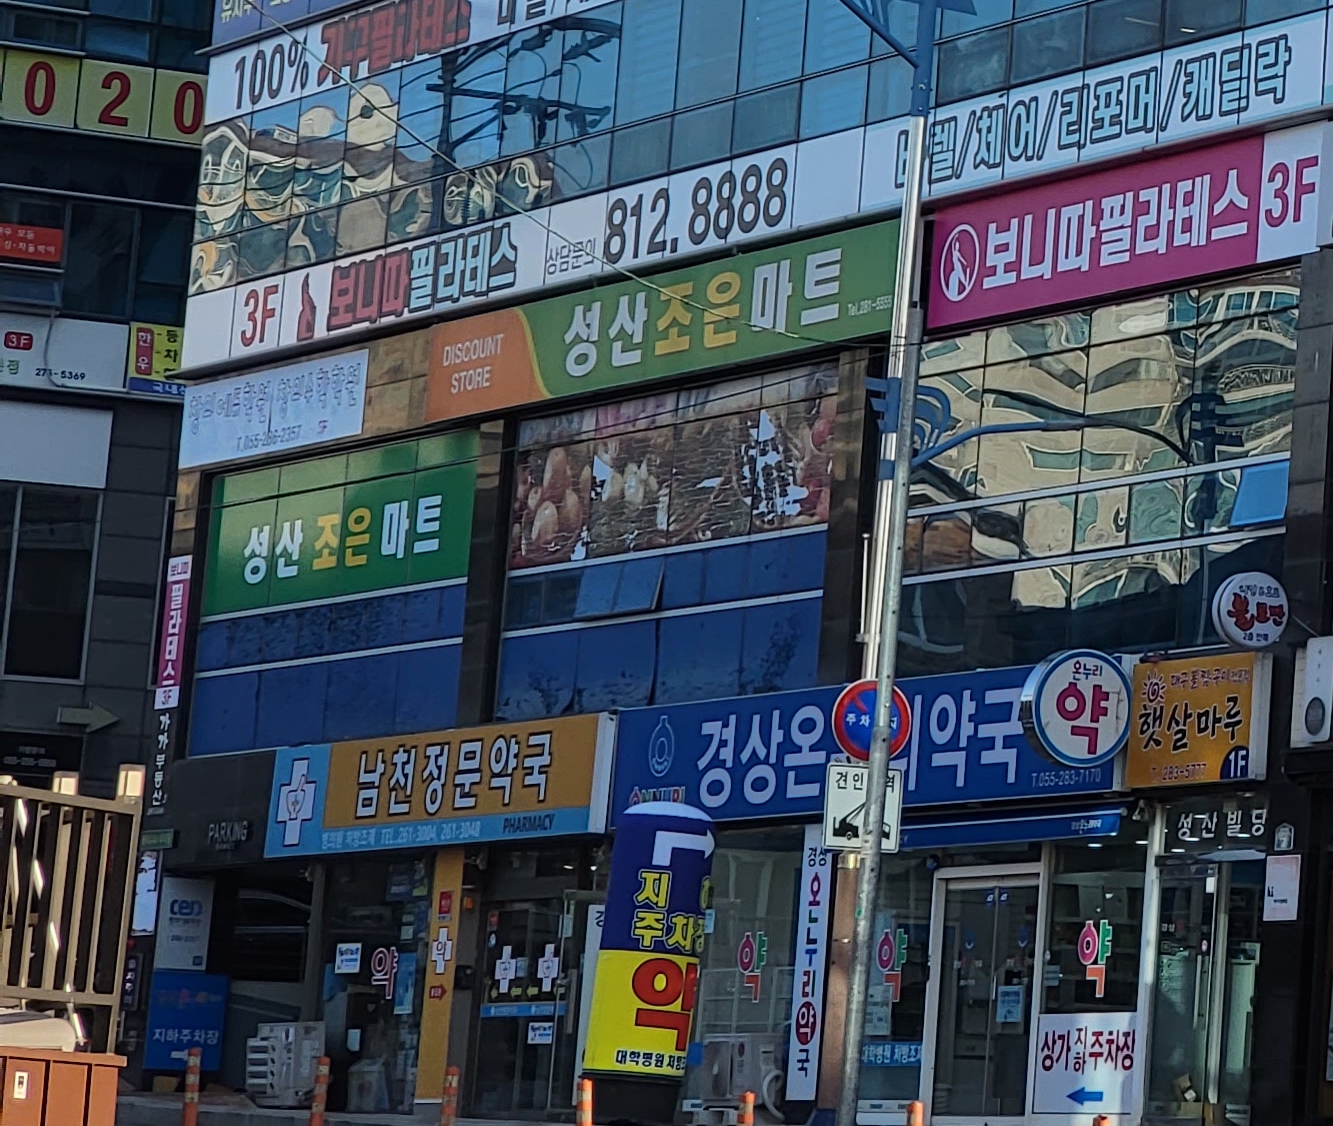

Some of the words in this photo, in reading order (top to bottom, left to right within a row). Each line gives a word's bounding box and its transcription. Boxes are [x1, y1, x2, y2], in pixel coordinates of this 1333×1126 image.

[234, 40, 308, 113] 100%
[981, 168, 1250, 290] 보니따필라테스
[1263, 154, 1319, 229] 3F
[239, 283, 279, 350] 3F
[545, 237, 597, 279] 상담문의
[688, 157, 788, 247] 8888
[7, 334, 30, 348] 3F
[442, 333, 505, 367] DISCOUNT
[450, 367, 492, 394] STORE
[161, 580, 186, 686] 필라테스
[1071, 659, 1104, 681] 온누리
[1056, 681, 1111, 756] 약
[1138, 686, 1246, 753] 햇살마루
[355, 730, 553, 820] 남천정문약국
[1031, 769, 1101, 788] T.055-283-7170
[1229, 748, 1249, 777] 1F
[207, 820, 249, 844] PARKING
[502, 813, 556, 834] PHARMACY
[1177, 806, 1268, 839] 성산빌딩
[370, 947, 400, 1000] 약
[737, 930, 769, 1004] 약
[1076, 919, 1113, 1000] 약
[151, 1028, 220, 1045] 지하주차장
[1041, 1028, 1071, 1073] 상가
[1088, 1027, 1136, 1073] 주차장
[614, 1048, 666, 1073] 대학병원
